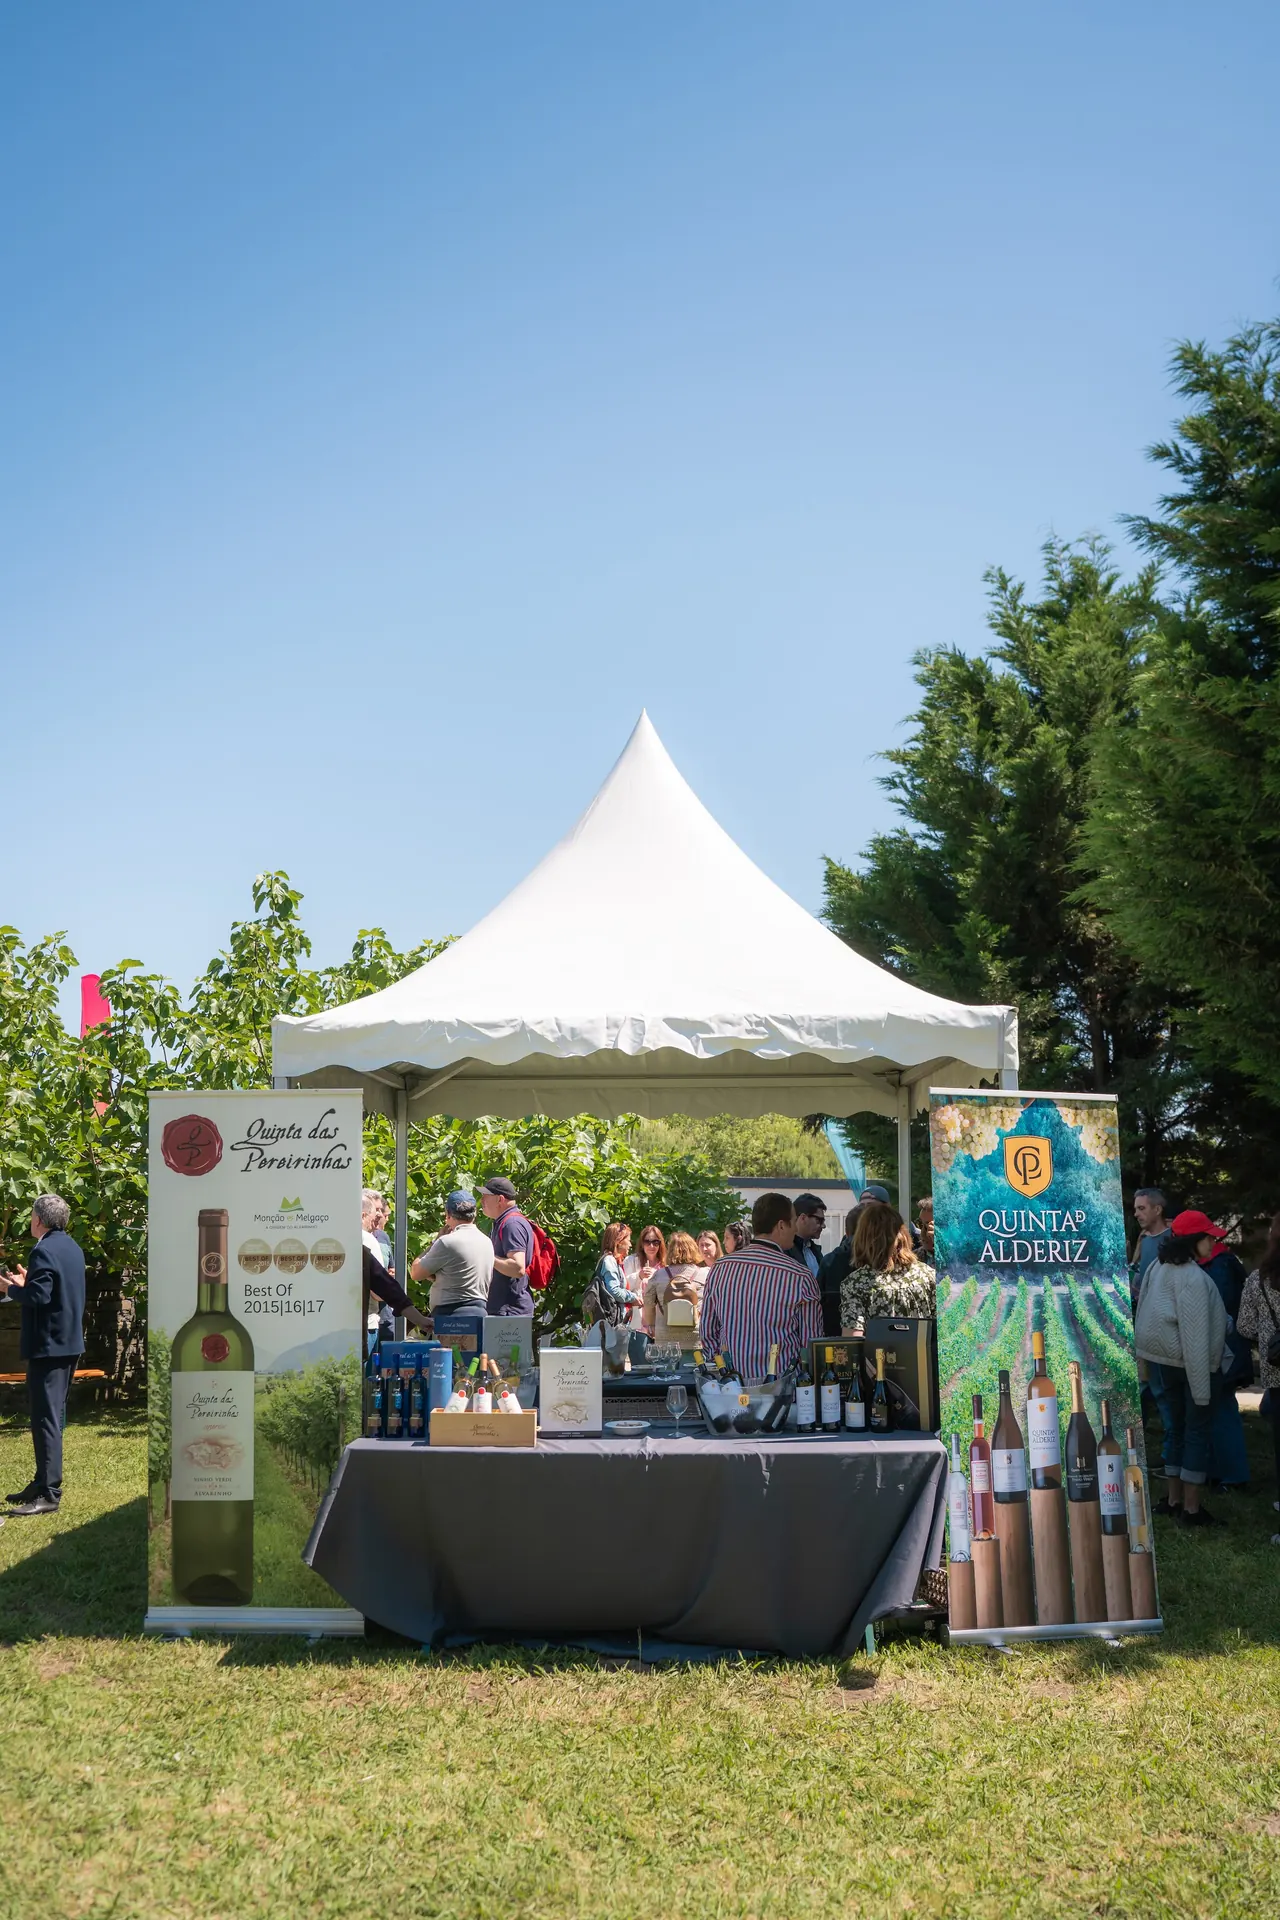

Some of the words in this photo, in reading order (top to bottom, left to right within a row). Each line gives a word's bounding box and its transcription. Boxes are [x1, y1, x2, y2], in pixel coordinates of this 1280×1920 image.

[243, 1118, 301, 1145] Quinta
[307, 1108, 340, 1140] das
[230, 1143, 352, 1172] Pereirinhas
[295, 1213, 330, 1224] Melgaço
[978, 1239, 1089, 1263] ALDERIZ
[244, 1285, 272, 1297] Best
[276, 1284, 294, 1297] Of
